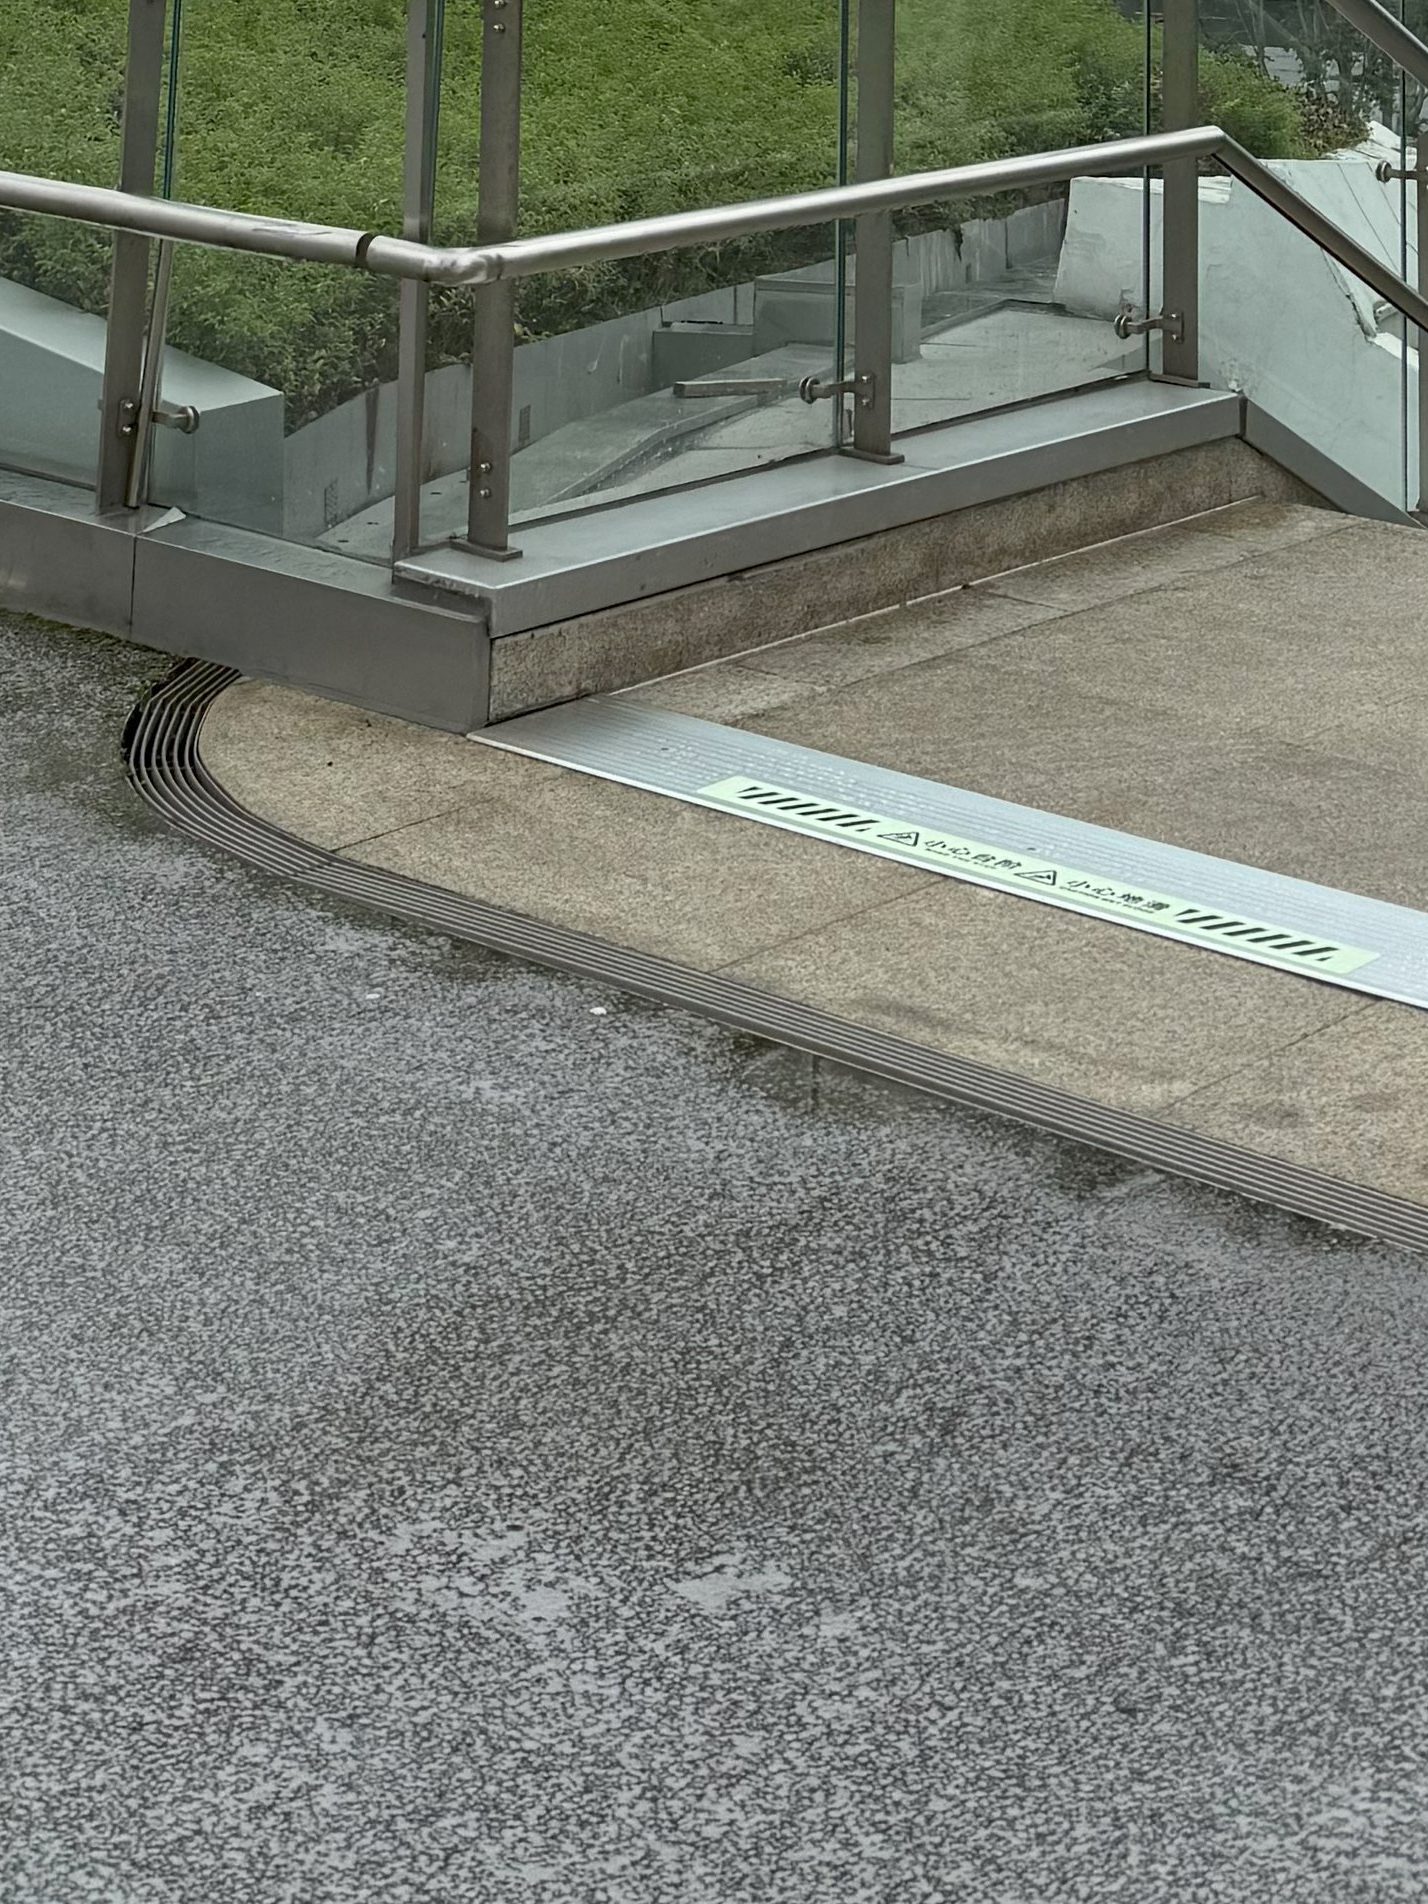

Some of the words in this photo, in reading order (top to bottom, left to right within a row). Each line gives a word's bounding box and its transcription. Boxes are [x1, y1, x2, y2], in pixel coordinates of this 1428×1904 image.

[923, 839, 1023, 870] 小心台阶
[1065, 879, 1172, 912] 小心地滑
